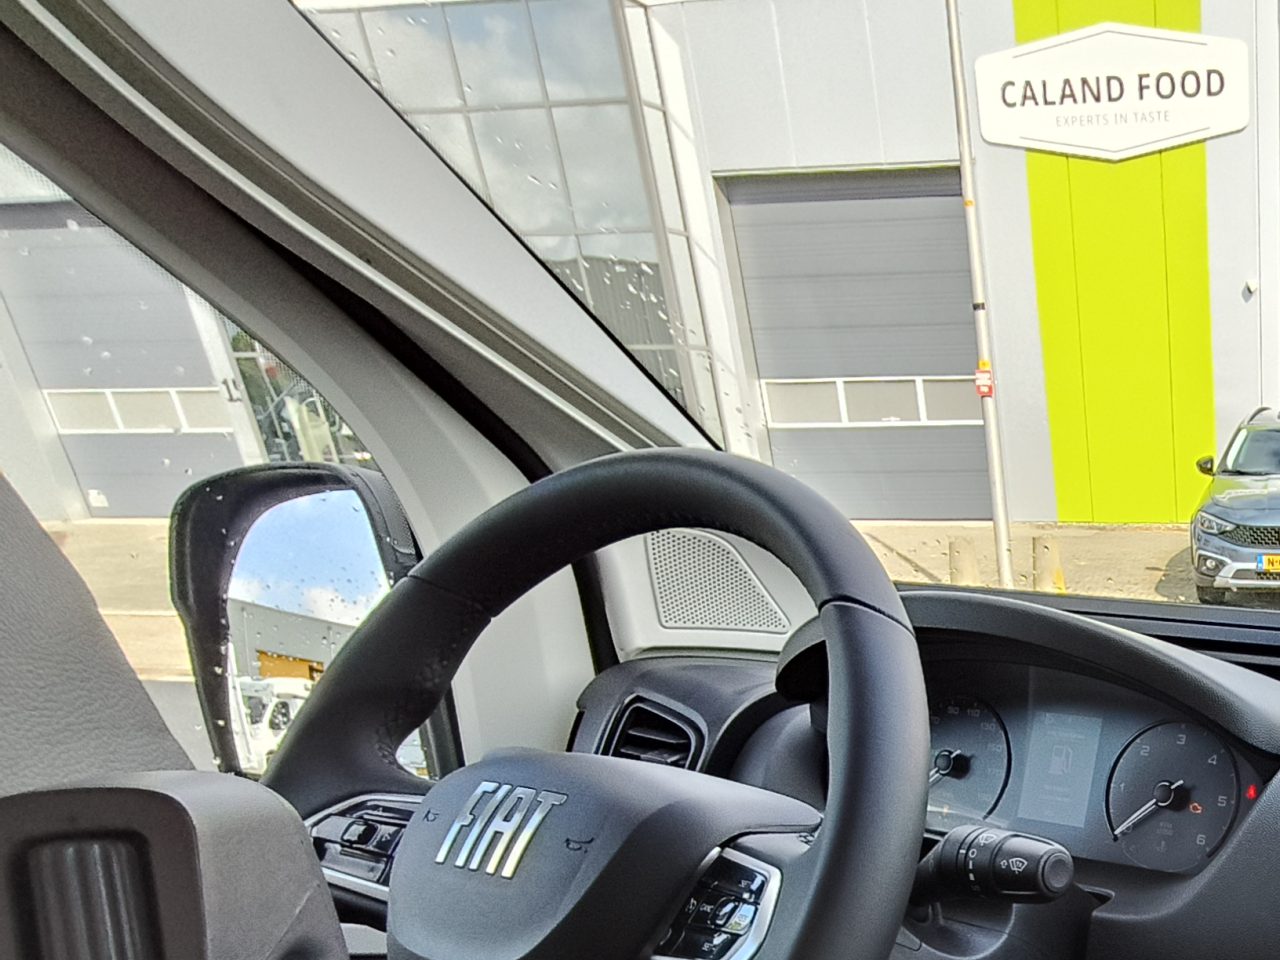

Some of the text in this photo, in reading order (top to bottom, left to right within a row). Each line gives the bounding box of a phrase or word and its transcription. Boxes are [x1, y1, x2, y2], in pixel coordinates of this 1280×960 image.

[1001, 69, 1225, 109] CALAND FOOD
[1056, 110, 1170, 127] EXPERTS IN TASTE
[1176, 734, 1187, 745] 3
[1140, 744, 1151, 756] 2
[1207, 754, 1218, 766] 4
[1217, 795, 1228, 807] 5
[434, 781, 568, 879] FIAT
[1196, 834, 1207, 846] 6
